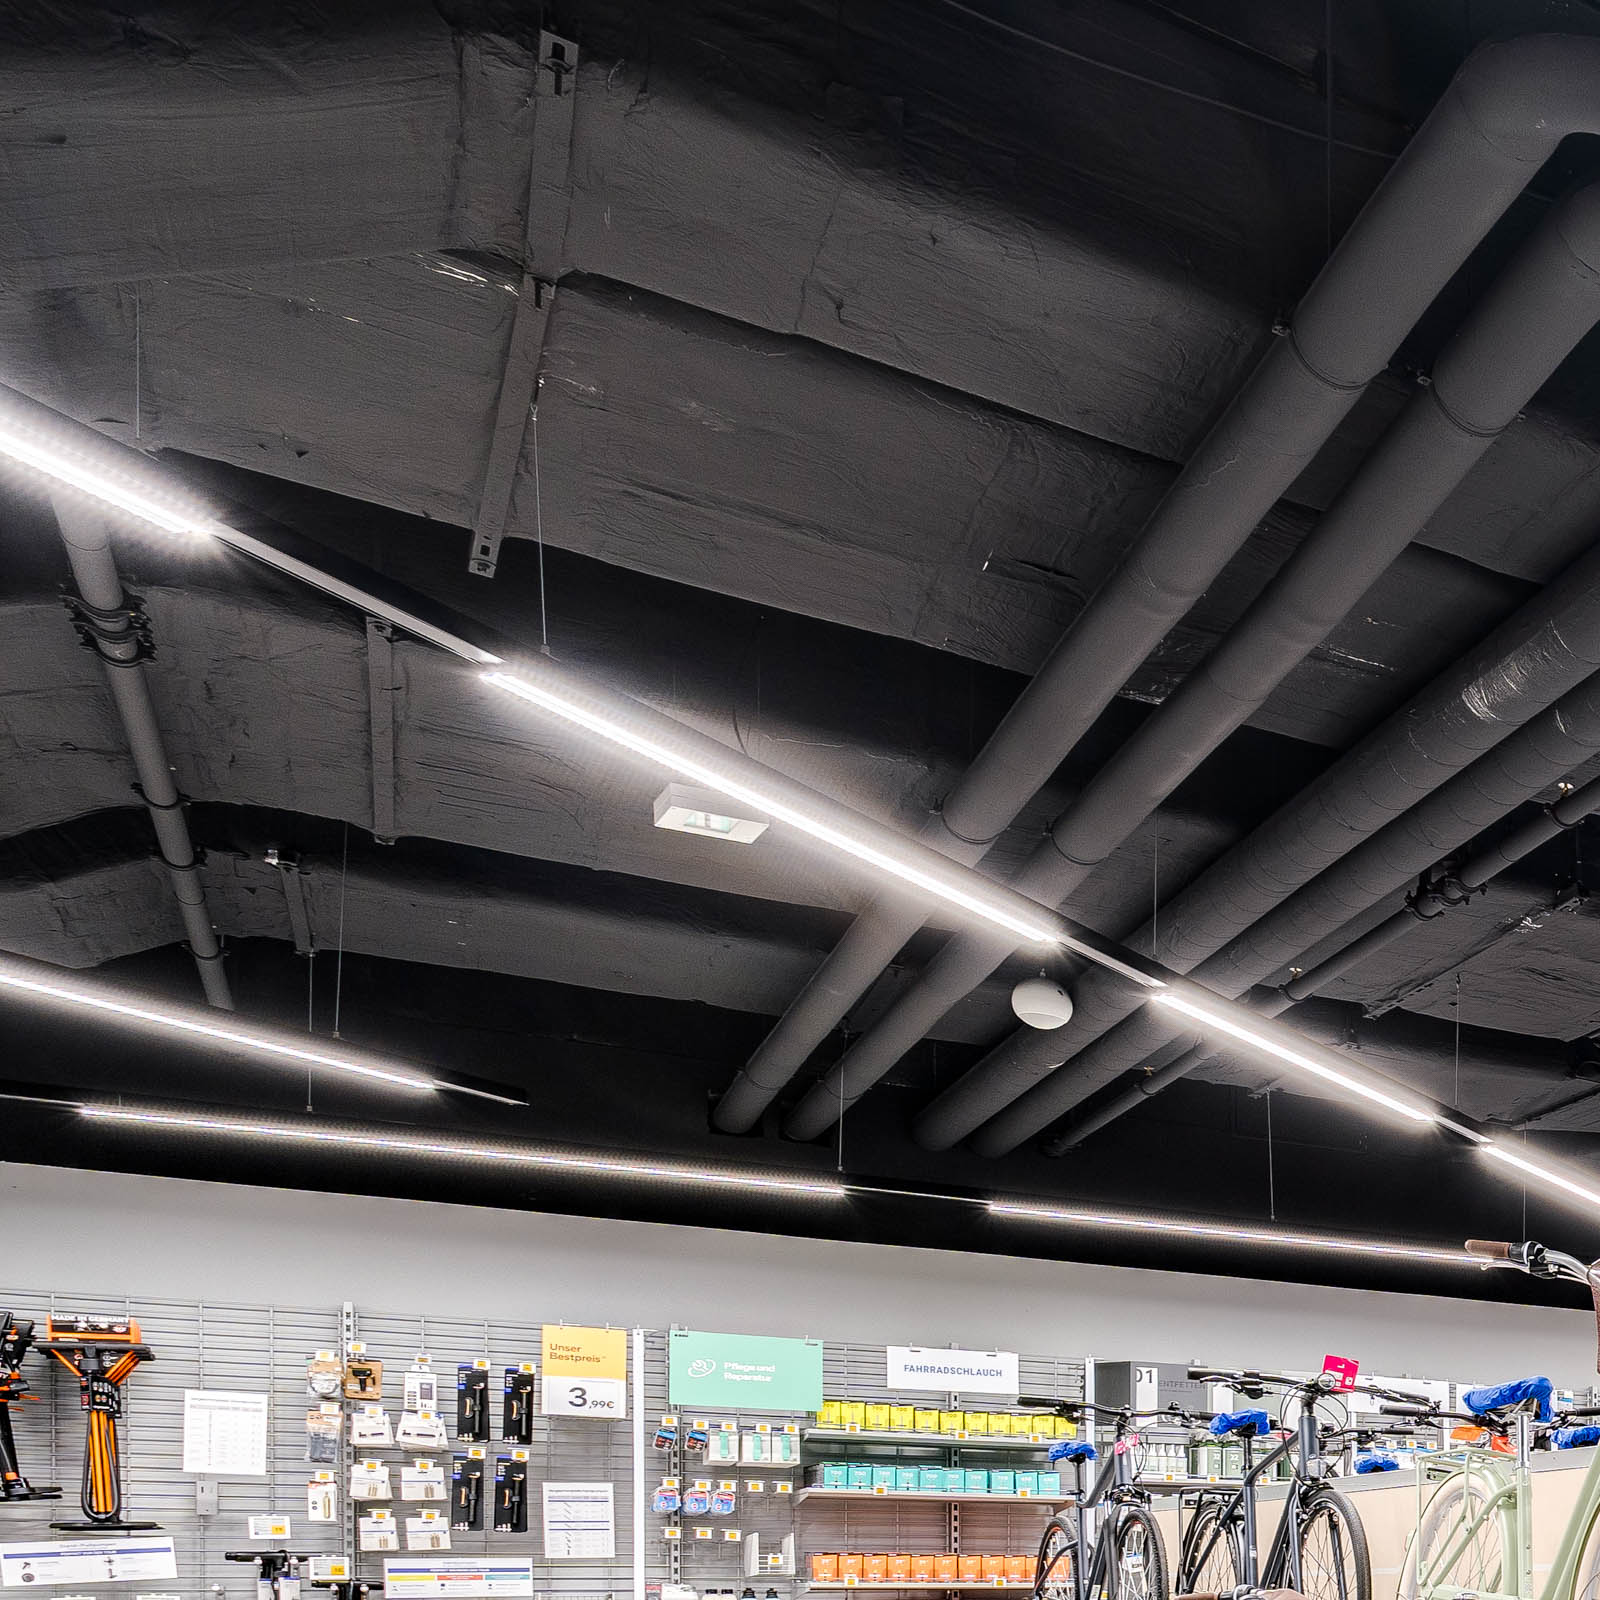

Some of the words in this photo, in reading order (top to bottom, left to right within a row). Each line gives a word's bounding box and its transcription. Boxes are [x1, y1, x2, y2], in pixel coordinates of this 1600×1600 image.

[550, 1343, 582, 1352] Unser
[549, 1352, 602, 1363] Bestpreis
[755, 1362, 776, 1373] und
[903, 1364, 1003, 1378] FAHRRADSCHLAUCH
[568, 1387, 615, 1409] 3,99€
